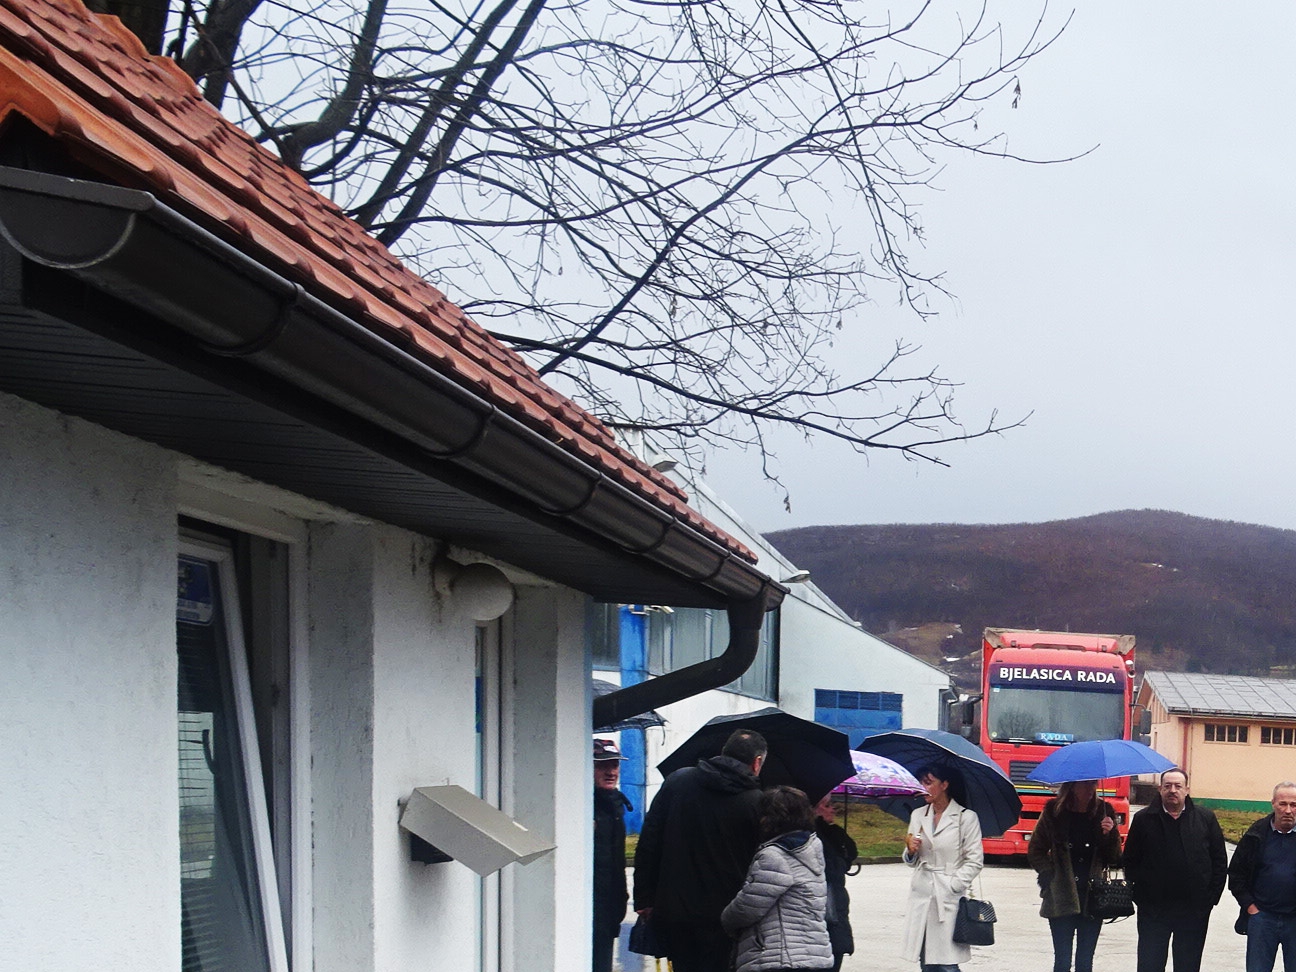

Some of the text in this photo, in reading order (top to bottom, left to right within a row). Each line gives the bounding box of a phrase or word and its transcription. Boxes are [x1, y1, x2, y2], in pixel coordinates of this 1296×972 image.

[1000, 667, 1116, 684] BJELASICA RADA
[1040, 732, 1068, 741] RADA
